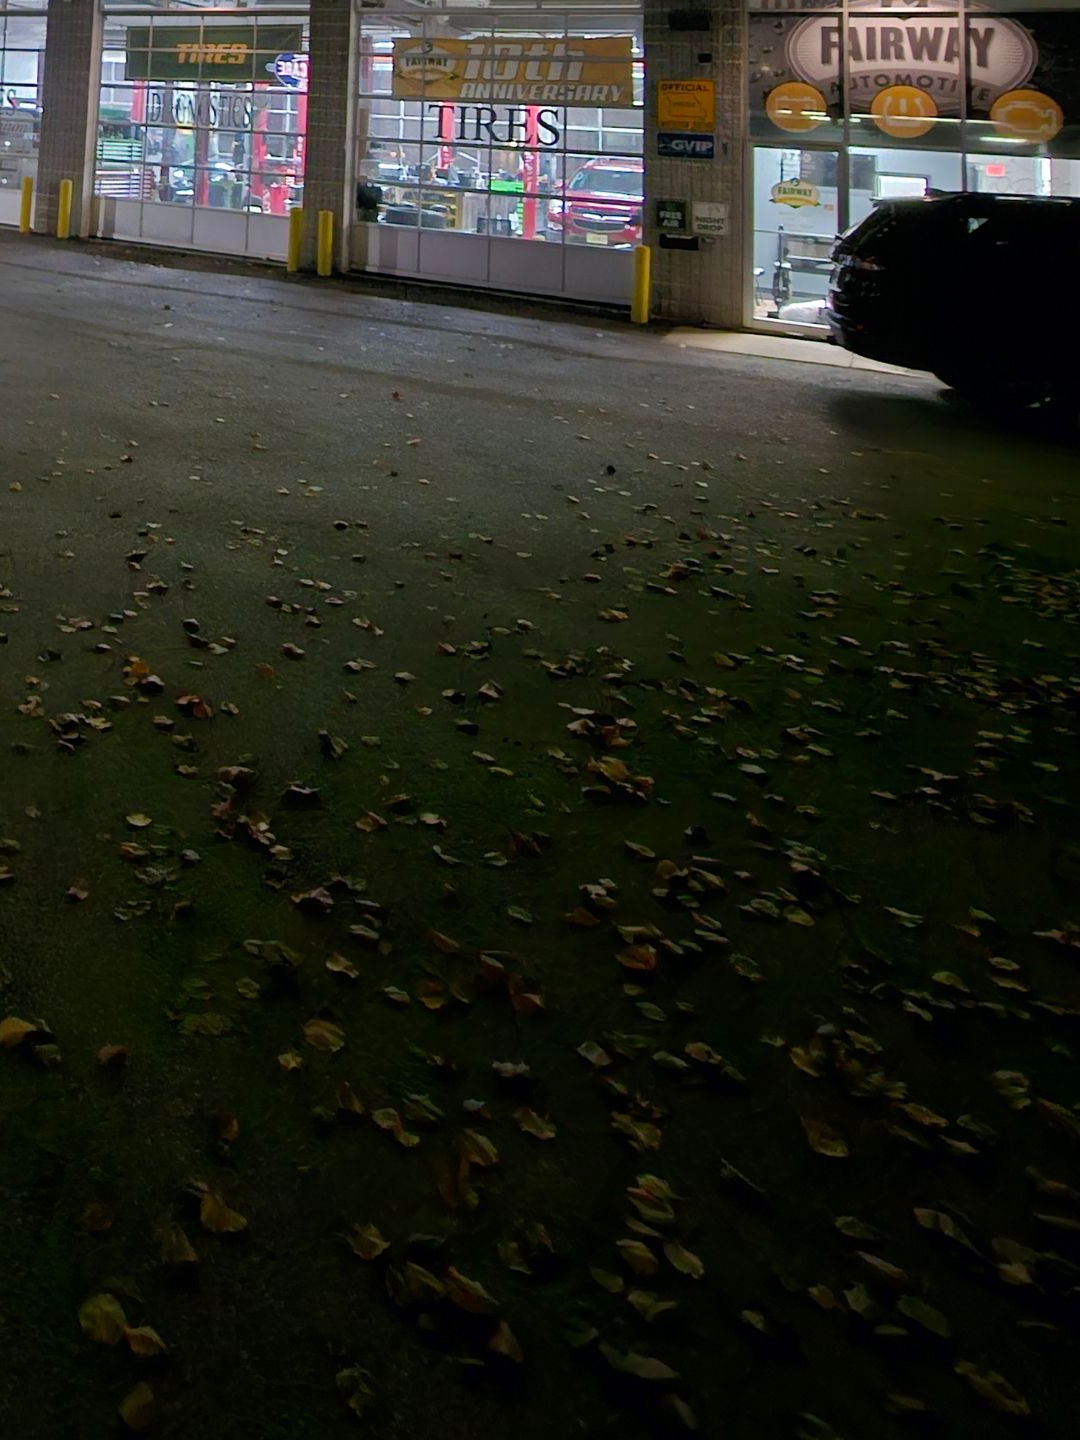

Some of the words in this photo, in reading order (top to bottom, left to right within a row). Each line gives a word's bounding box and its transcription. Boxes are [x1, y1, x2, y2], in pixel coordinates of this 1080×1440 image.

[176, 44, 248, 65] TIRES
[464, 43, 585, 81] 10th
[460, 83, 624, 102] ANNIVERSARY
[661, 83, 711, 92] OFFICIAL
[831, 74, 991, 101] AUTOMOTIE
[428, 104, 560, 145] TIRES
[671, 139, 713, 152] GVIP
[777, 186, 813, 197] FAIRWAY
[659, 210, 682, 220] FREE
[695, 215, 725, 224] NIGHT
[662, 219, 680, 228] AIR
[696, 223, 724, 231] DROP
